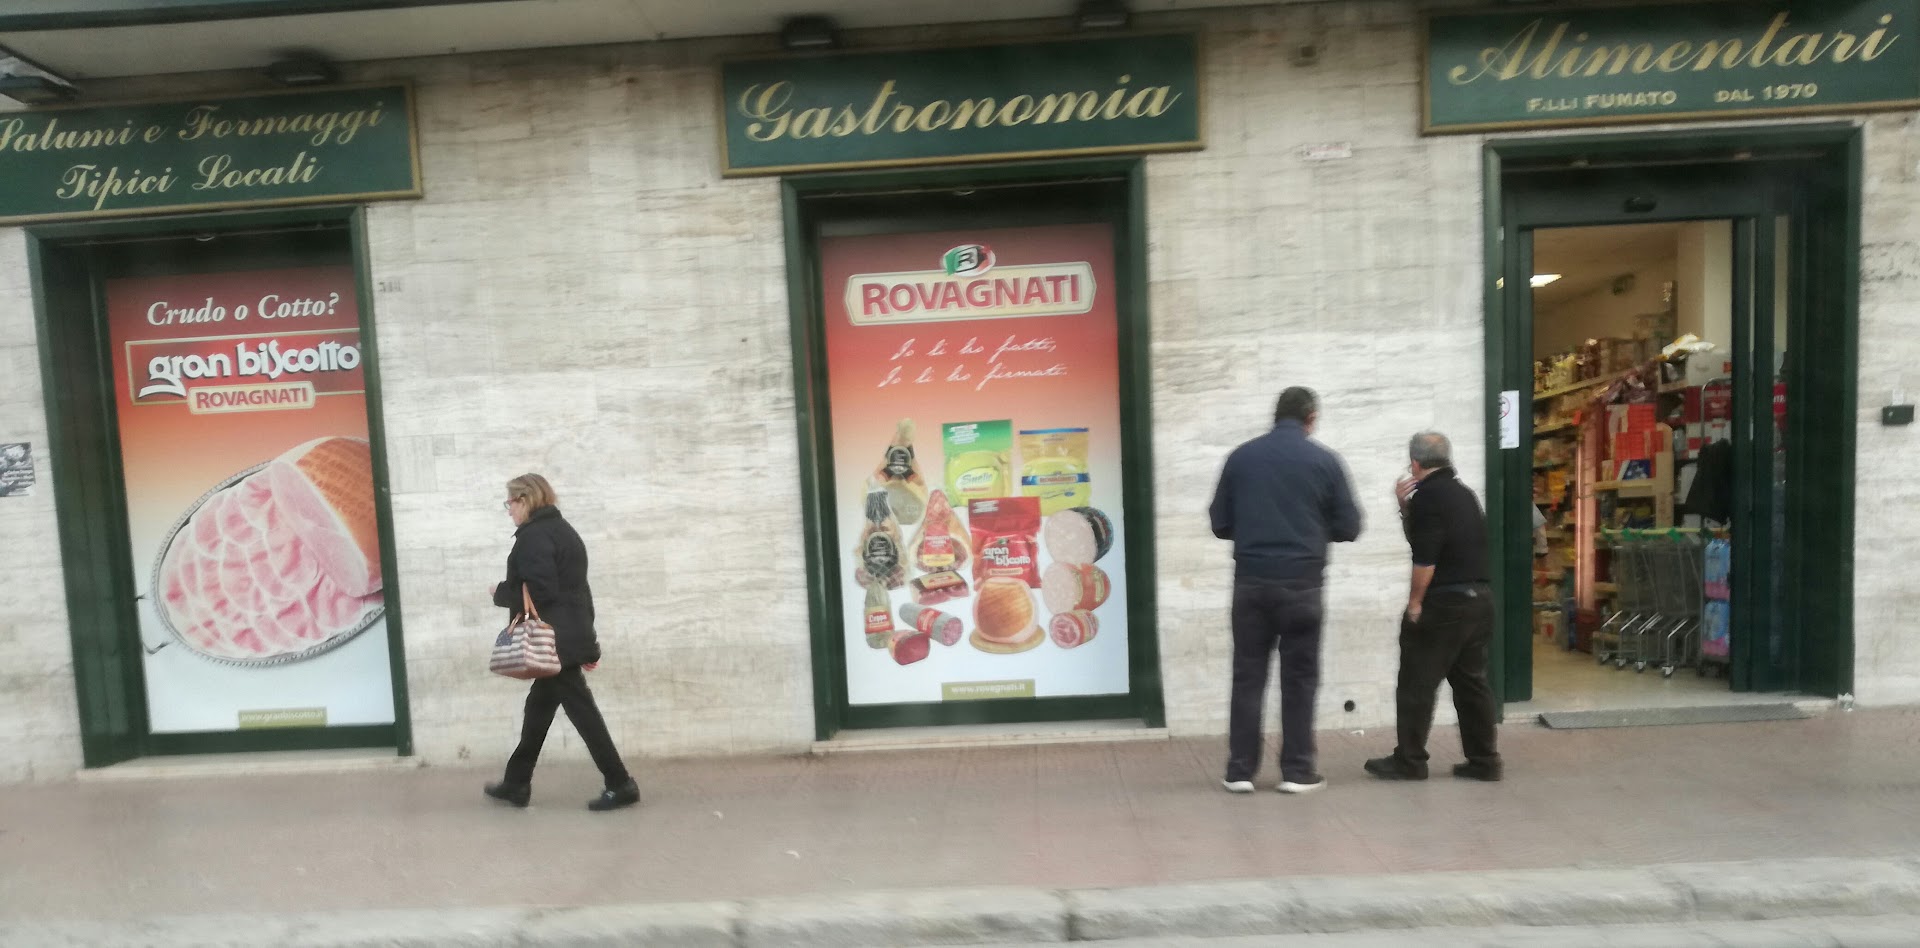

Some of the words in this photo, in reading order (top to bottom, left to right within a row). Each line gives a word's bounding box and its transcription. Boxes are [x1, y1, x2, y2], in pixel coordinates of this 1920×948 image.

[1448, 11, 1900, 86] Alimentari
[738, 74, 1183, 142] Gastronomia
[1586, 90, 1678, 110] FUMATO
[1715, 87, 1755, 103] DAL
[1763, 83, 1818, 100] 1970
[0, 118, 140, 152] Salumi
[143, 125, 170, 143] e
[179, 101, 388, 146] Formaggi
[56, 164, 179, 210] Tipici
[192, 151, 325, 191] Locali
[147, 297, 226, 326] Crudo
[234, 305, 249, 321] o
[258, 292, 340, 319] Cotto?
[862, 274, 1080, 316] ROVAGNATI
[138, 353, 231, 398] gran
[196, 387, 308, 409] ROVAGNATI
